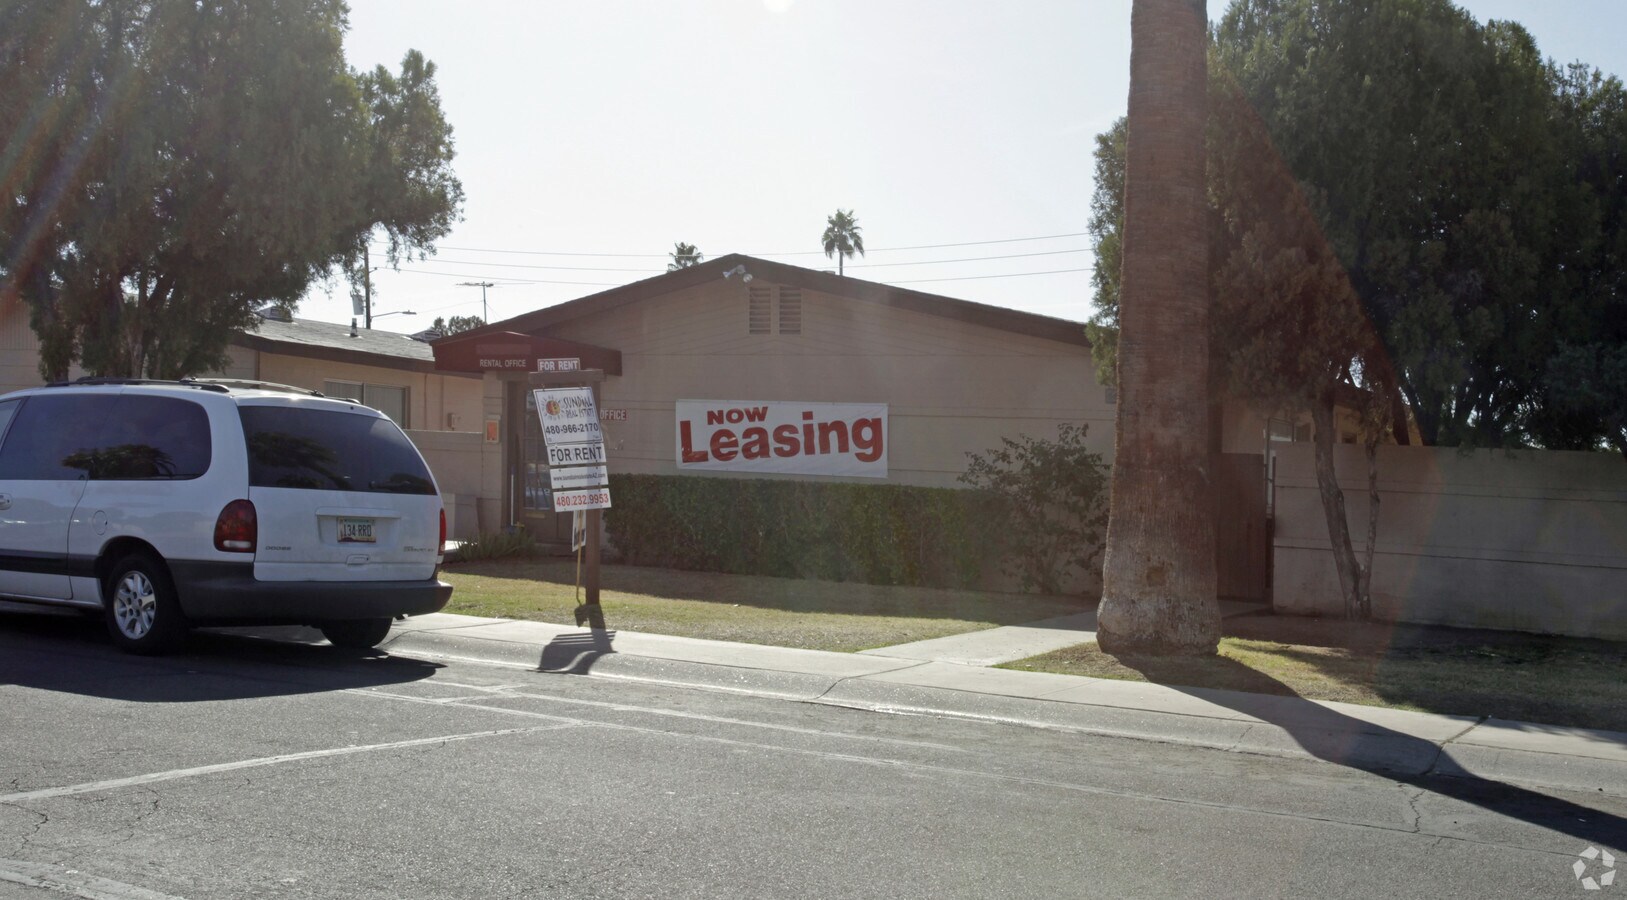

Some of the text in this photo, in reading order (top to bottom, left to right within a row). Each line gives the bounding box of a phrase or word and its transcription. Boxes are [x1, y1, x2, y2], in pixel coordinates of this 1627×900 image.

[479, 359, 527, 368] RENTAL OFFICE
[539, 360, 578, 370] FOR RENT
[600, 409, 626, 420] OFFICE
[707, 406, 768, 425] NOW
[545, 423, 598, 434] 480-966-2170
[680, 411, 883, 463] Leasing
[550, 446, 602, 462] FOR RENT
[556, 494, 608, 506] 480.232.9953
